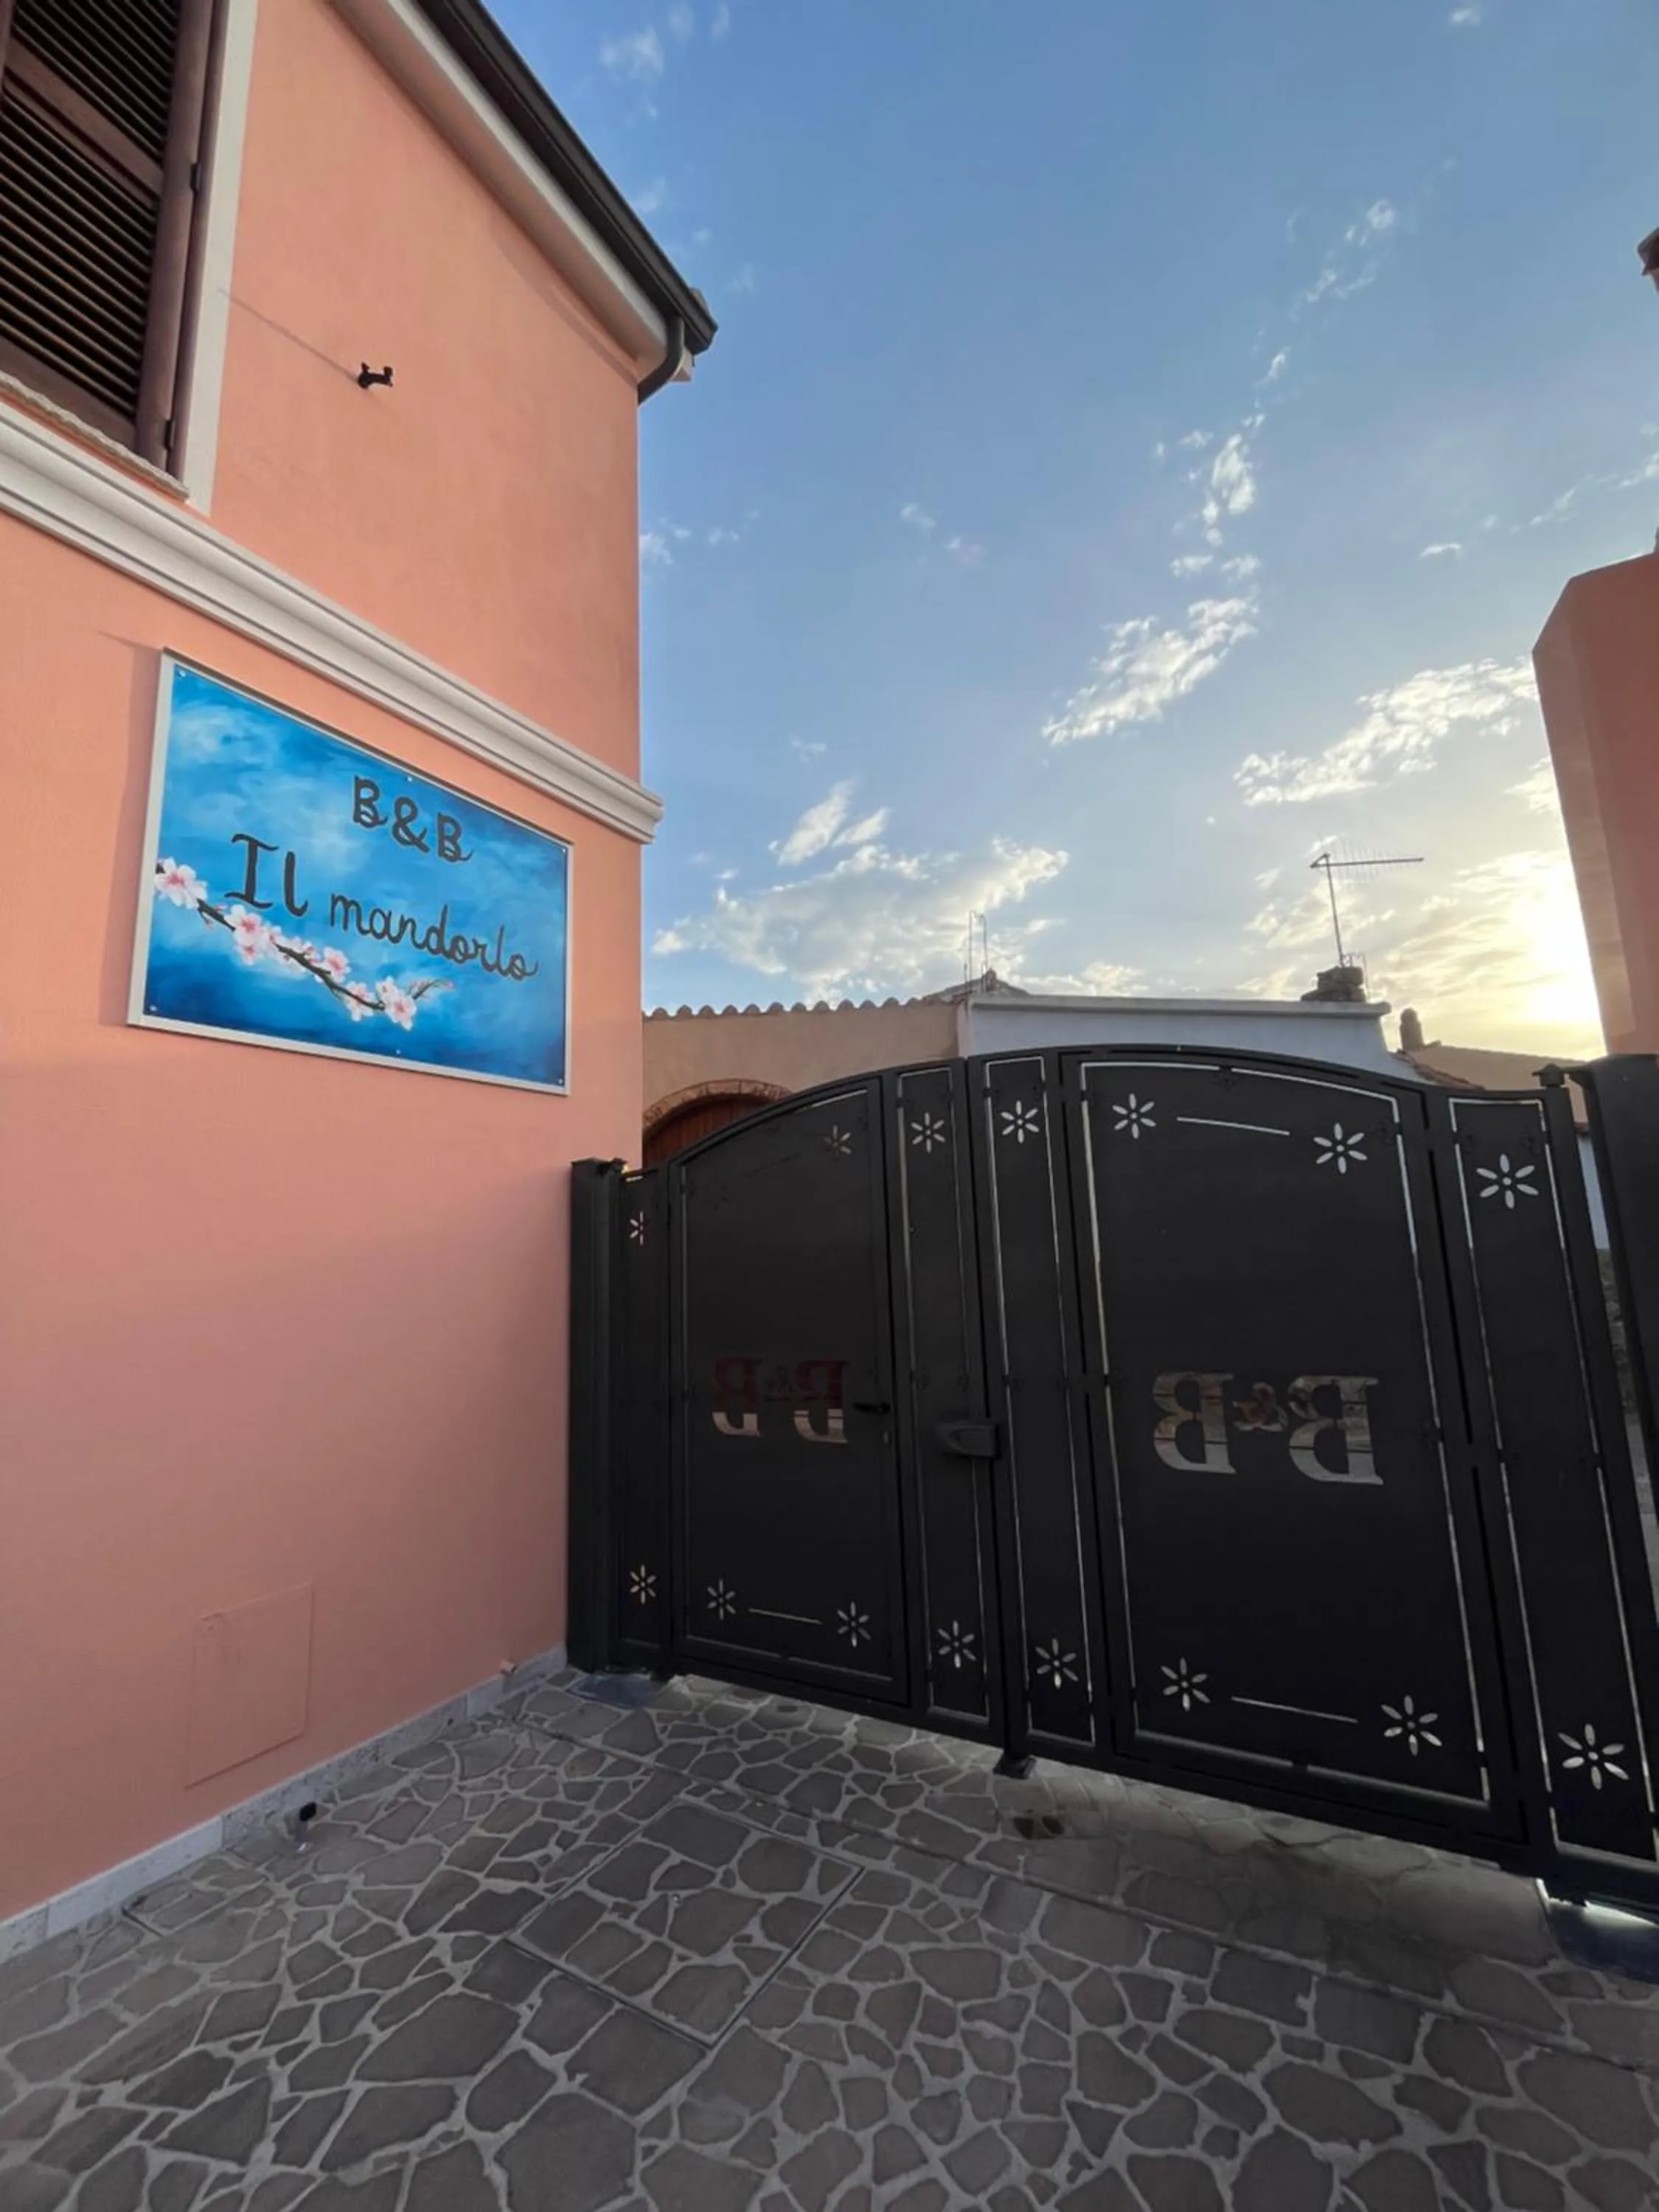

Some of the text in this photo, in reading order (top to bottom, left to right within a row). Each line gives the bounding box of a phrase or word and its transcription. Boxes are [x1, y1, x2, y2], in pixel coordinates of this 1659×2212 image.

[353, 776, 473, 863] B&B
[224, 833, 538, 980] Il mandorlo
